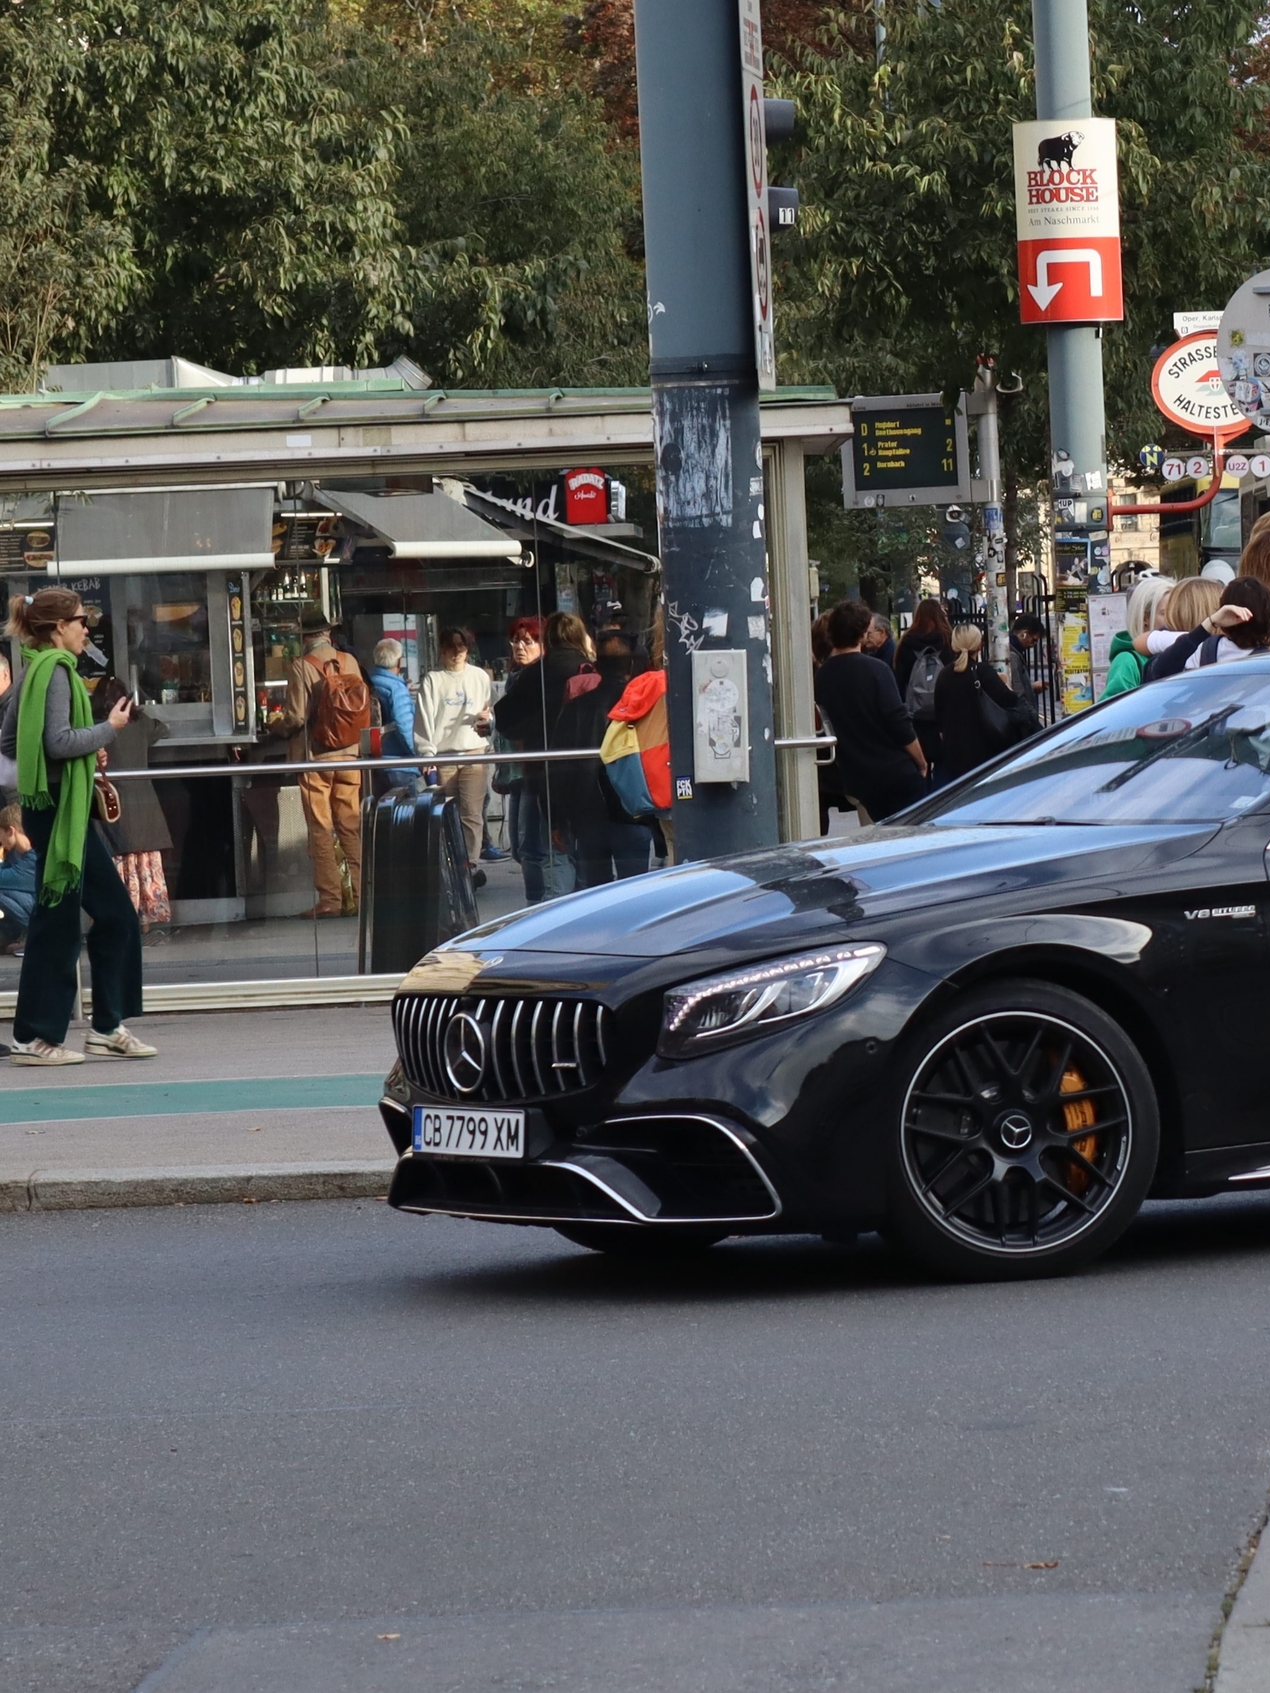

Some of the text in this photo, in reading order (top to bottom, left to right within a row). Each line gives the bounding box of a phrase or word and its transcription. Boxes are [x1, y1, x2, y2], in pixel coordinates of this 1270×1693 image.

[1027, 169, 1098, 187] BLOCK
[1027, 186, 1099, 205] HOUSE
[1028, 215, 1100, 226] Am Naschmarkt
[861, 423, 868, 436] D
[862, 443, 868, 456] 1
[946, 438, 953, 452] 2
[863, 463, 870, 476] 2
[941, 458, 954, 471] 11
[1166, 463, 1182, 475] 71
[1193, 462, 1203, 474] 2
[1228, 462, 1247, 471] U2Z
[1259, 460, 1265, 472] 1
[70, 577, 101, 592] KEBAB
[677, 779, 691, 788] FCK
[677, 788, 693, 797] PTN
[1184, 909, 1210, 920] V8
[1212, 905, 1256, 915] BITURBO
[424, 1113, 520, 1152] CB 7799 XM
